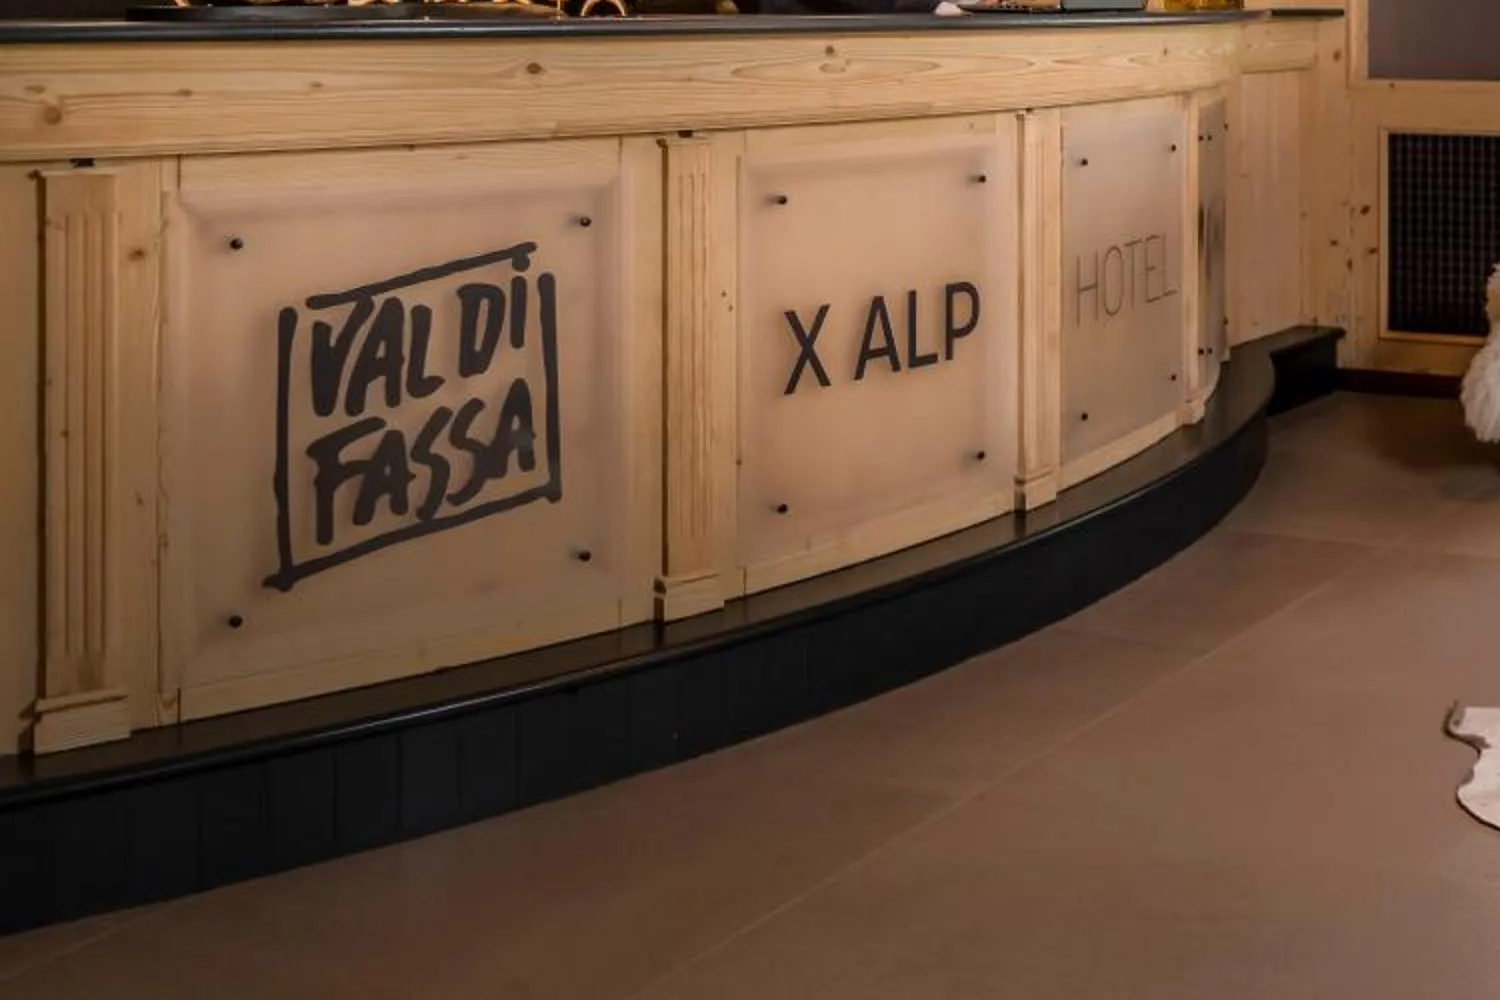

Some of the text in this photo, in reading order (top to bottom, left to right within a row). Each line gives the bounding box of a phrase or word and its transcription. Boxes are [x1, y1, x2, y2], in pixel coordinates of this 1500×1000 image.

[784, 281, 981, 396] X ALP
[1076, 231, 1179, 329] HOTEL
[312, 296, 445, 417] VAL
[306, 379, 537, 546] FASSA
